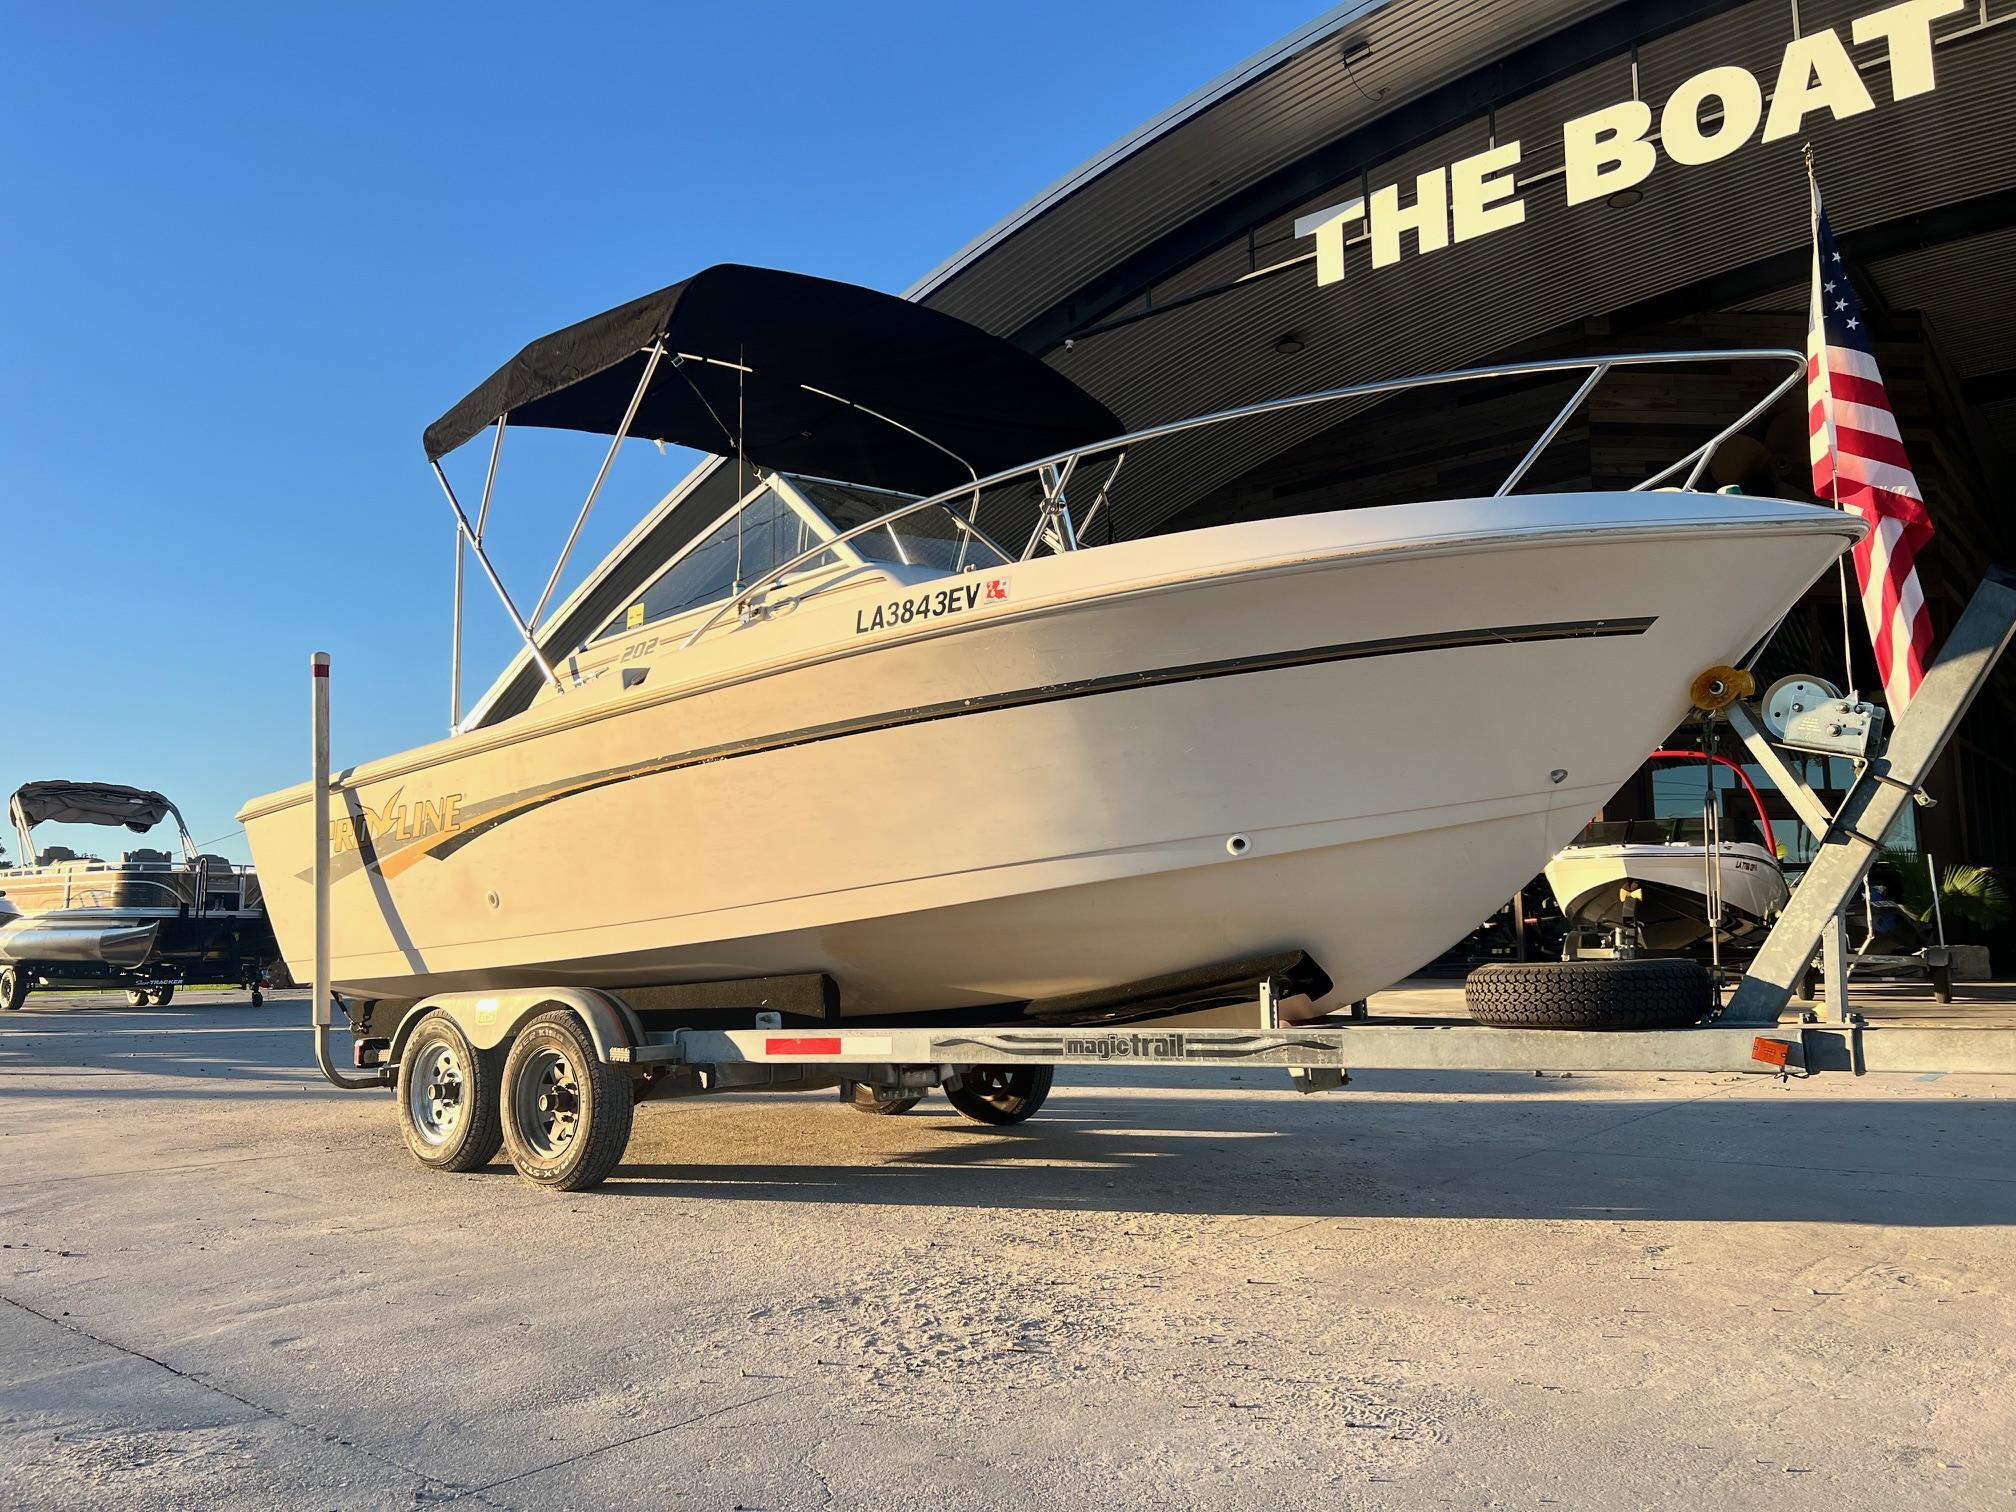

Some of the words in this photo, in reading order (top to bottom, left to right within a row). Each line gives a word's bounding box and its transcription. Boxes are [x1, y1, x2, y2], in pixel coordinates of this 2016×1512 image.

[1294, 140, 1526, 288] THE
[1563, 0, 1965, 207] BOAT
[856, 582, 981, 634] LA3843EV
[620, 636, 659, 663] 202
[1066, 1033, 1184, 1061] magictrail
